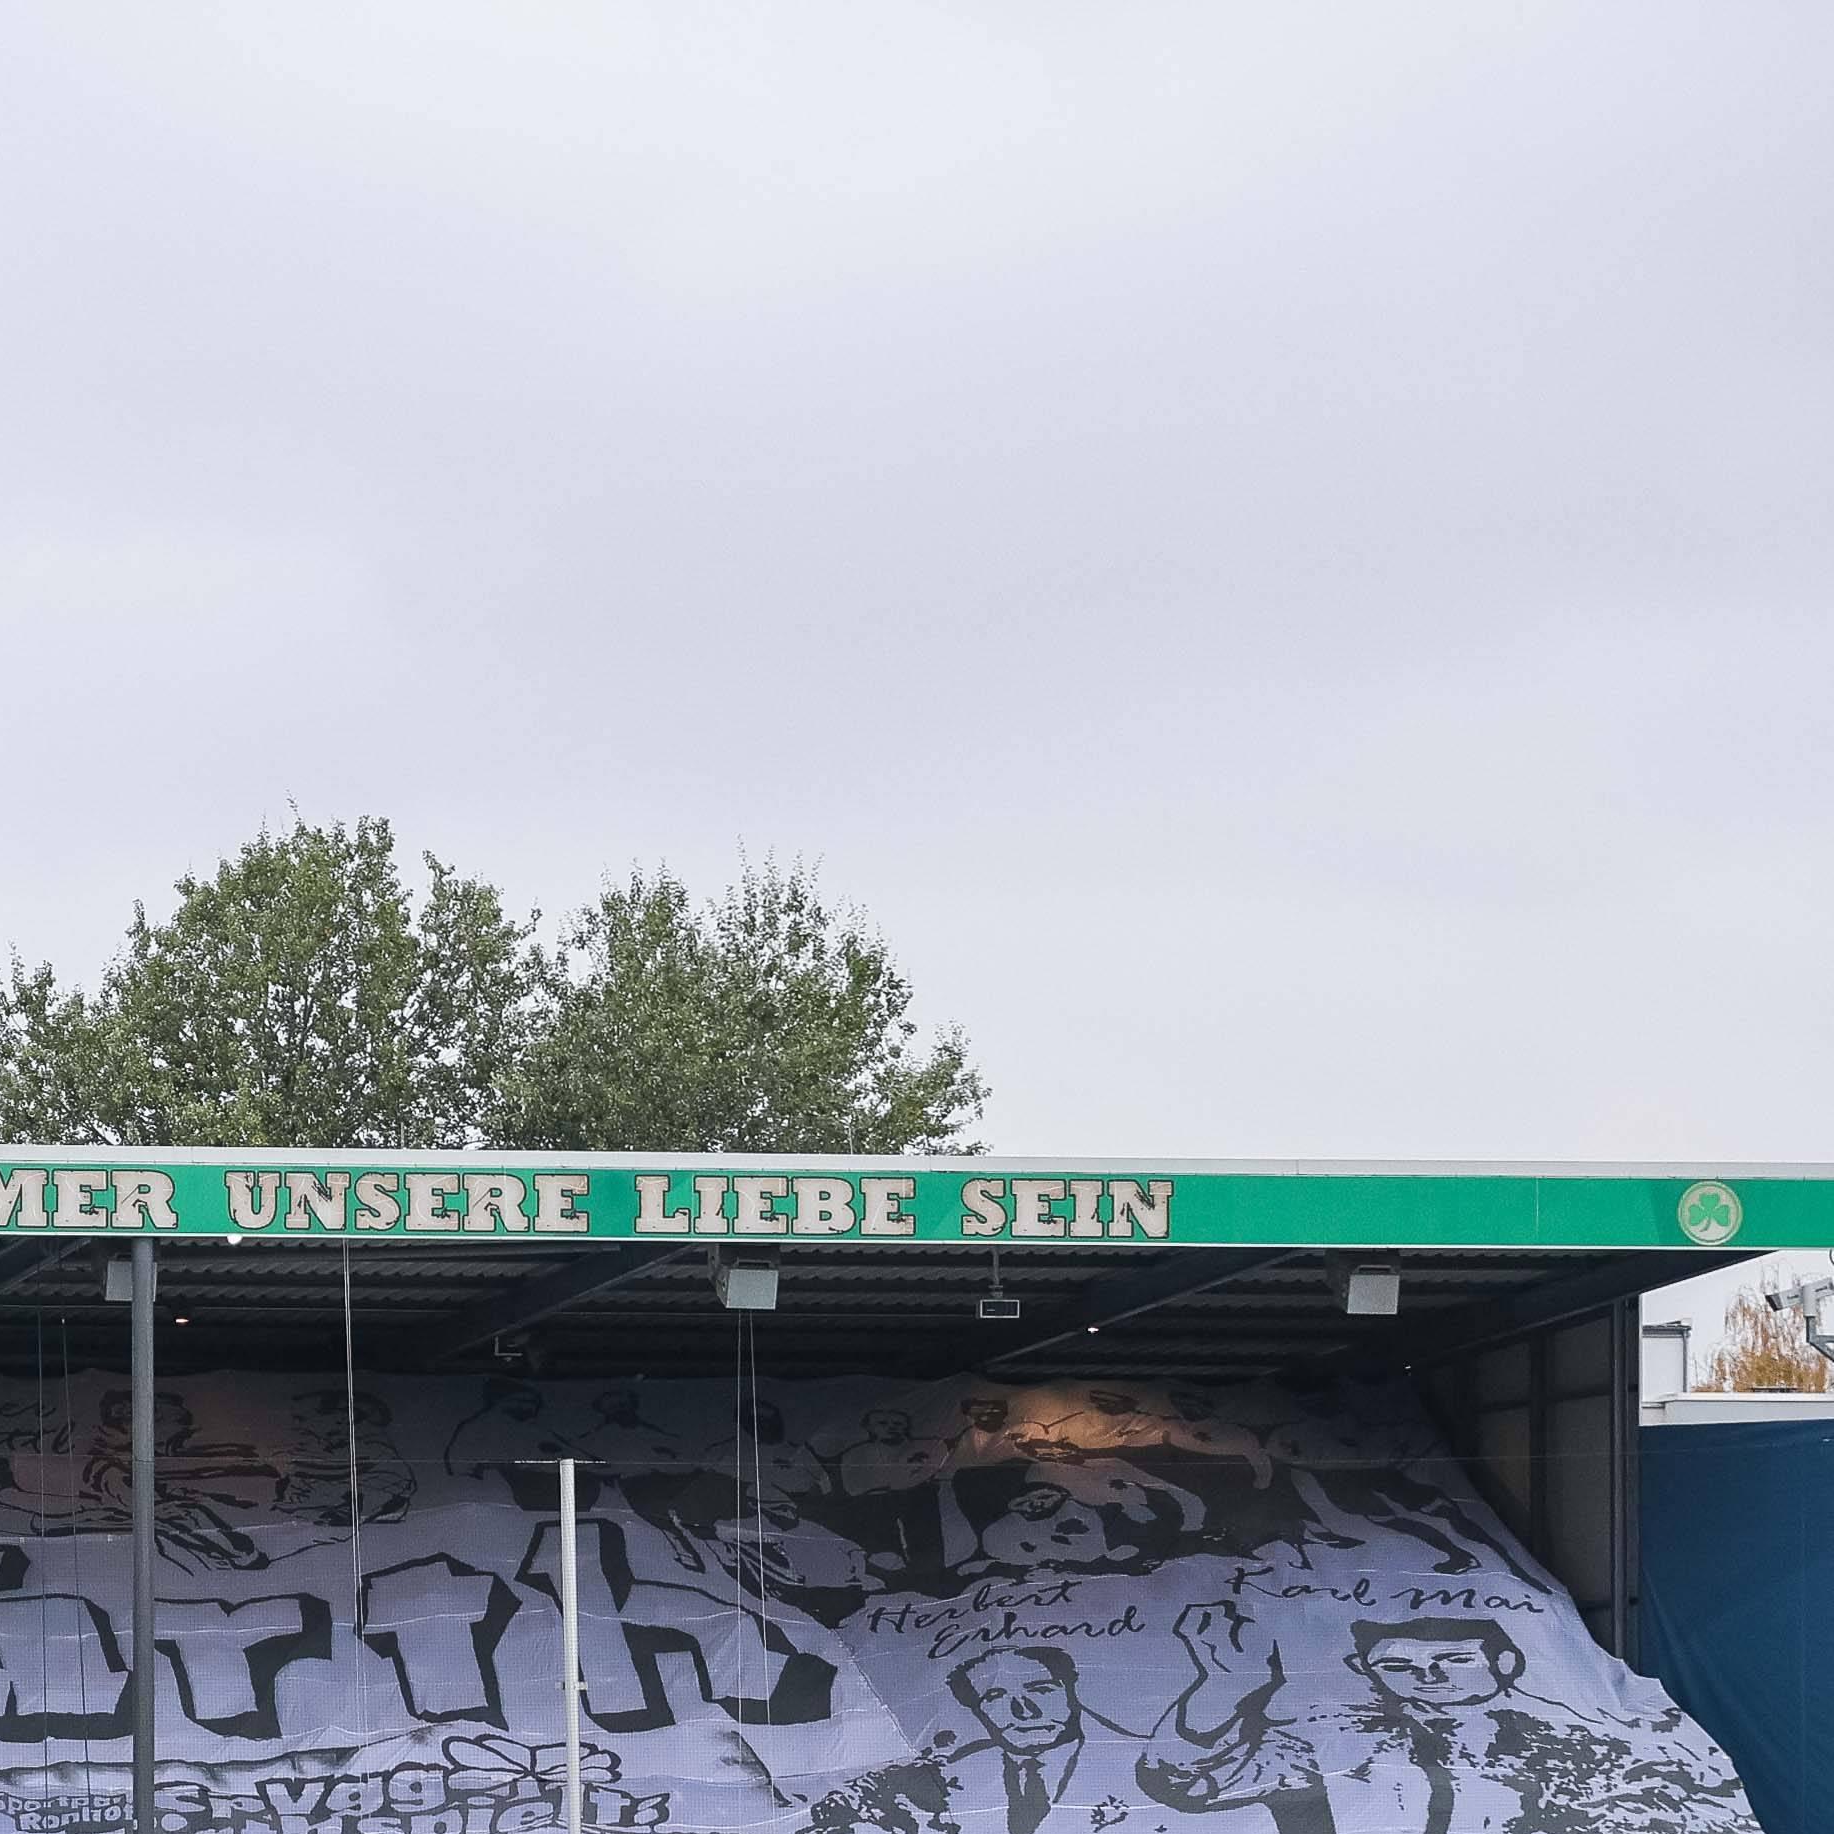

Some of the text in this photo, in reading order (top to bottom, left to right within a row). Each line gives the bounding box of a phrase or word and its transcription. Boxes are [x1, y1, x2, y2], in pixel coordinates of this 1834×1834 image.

[223, 1169, 590, 1234] UNSERE
[634, 1174, 917, 1237] LIEBE
[960, 1178, 1175, 1240] SEIN
[867, 1577, 1083, 1635] Herbert
[1231, 1564, 1548, 1615] Karl Mai
[928, 1601, 1147, 1660] Erhard
